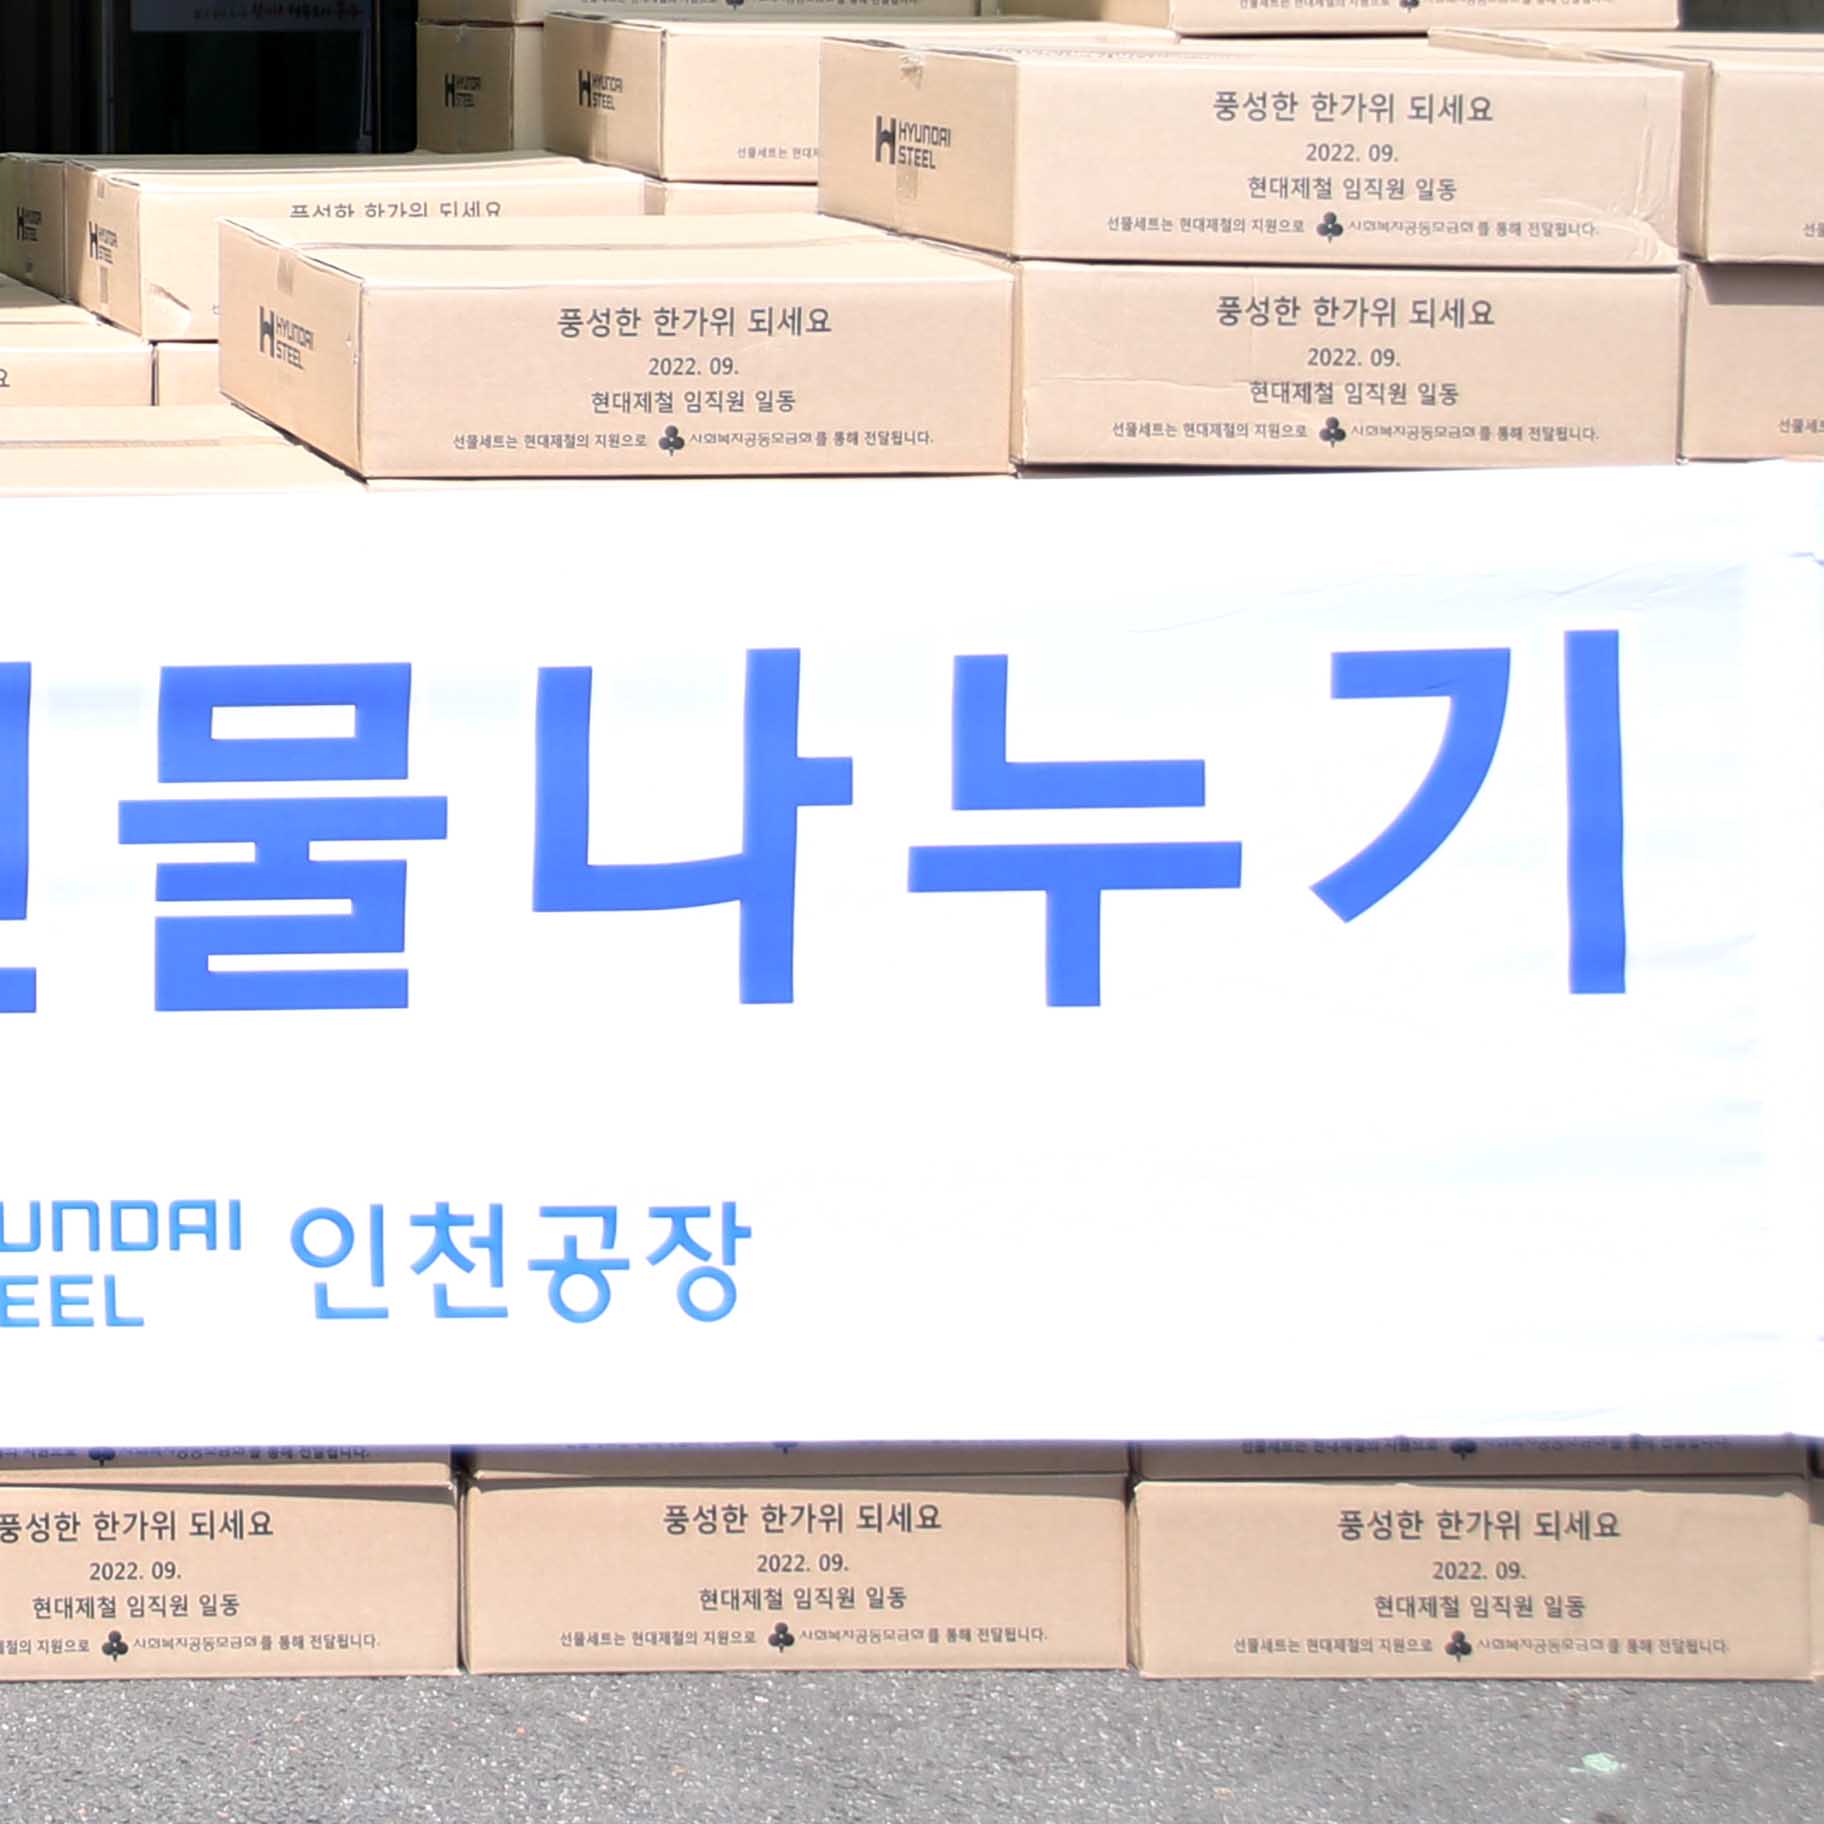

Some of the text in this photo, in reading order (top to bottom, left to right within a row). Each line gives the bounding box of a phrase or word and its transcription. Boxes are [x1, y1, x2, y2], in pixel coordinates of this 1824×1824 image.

[898, 120, 951, 147] HYUNDAI
[898, 145, 936, 169] STEEL
[276, 316, 314, 350] HYUNDAI
[558, 306, 832, 338] 풍성한 한가위 되세요
[277, 340, 304, 370] STEEL
[649, 357, 739, 376] 2022. 09.
[592, 390, 796, 414] 현대제철 임직원 일동
[288, 1198, 754, 1326] 인천공장
[1337, 1509, 1621, 1541] 풍성한 한가위 되세요
[1432, 1561, 1526, 1580] 2022. 09.
[1374, 1595, 1586, 1619] 현대제철 임직원 일동
